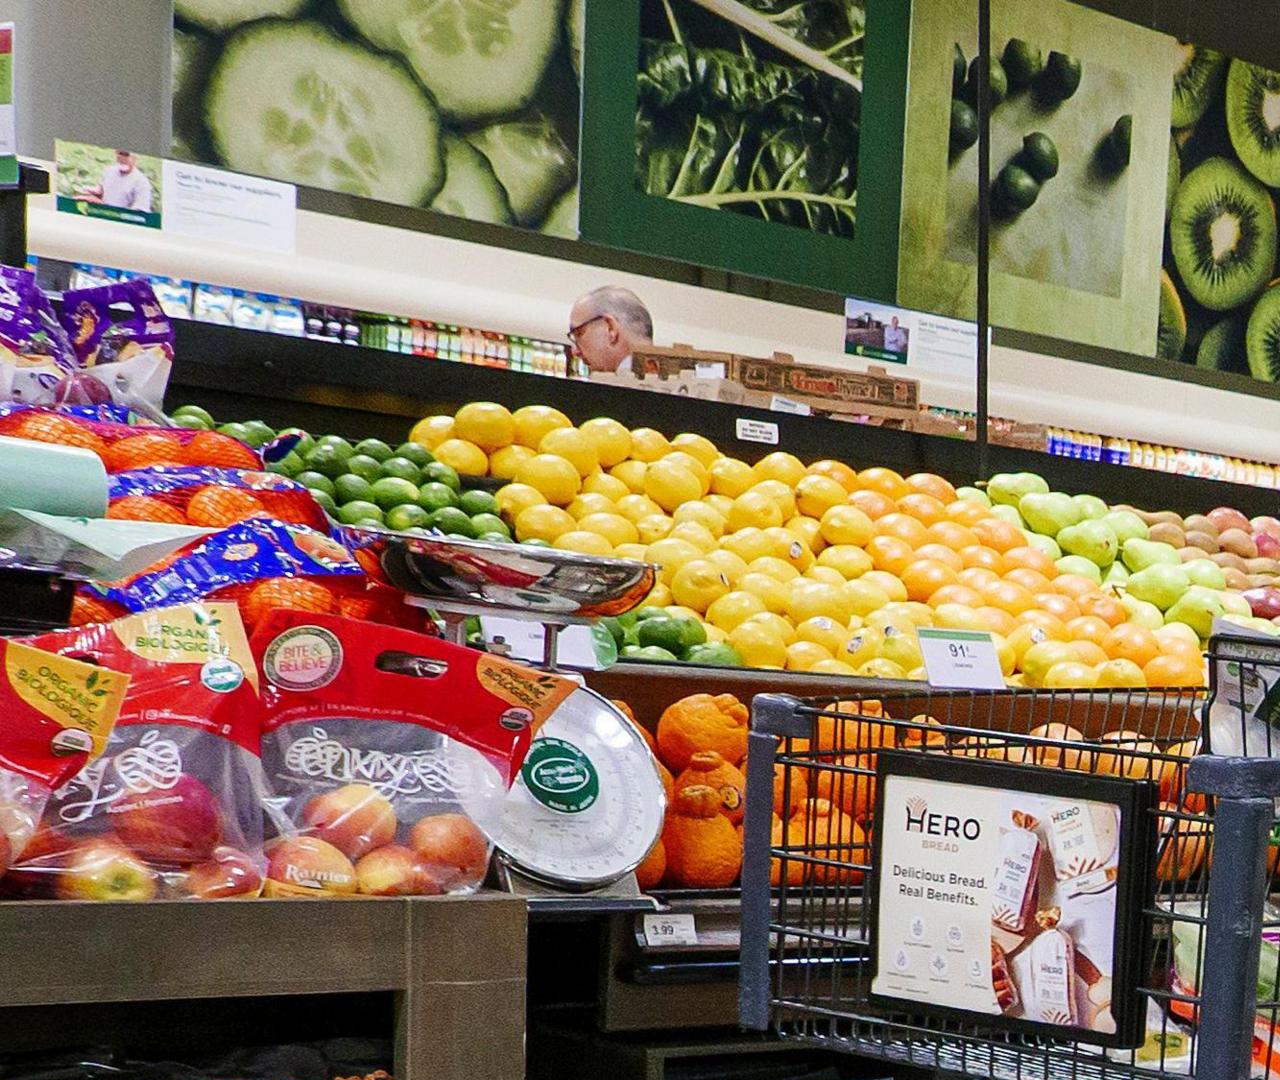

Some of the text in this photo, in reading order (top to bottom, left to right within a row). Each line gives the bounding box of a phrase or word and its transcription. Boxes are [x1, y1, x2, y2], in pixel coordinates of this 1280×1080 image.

[284, 645, 309, 659] BITE
[279, 658, 327, 673] BELIEVE
[38, 665, 99, 714] ORGANIC
[499, 666, 546, 700] ORGANIC
[16, 668, 99, 732] BIOLOGIQUE
[906, 806, 981, 841] HERO
[1052, 807, 1080, 824] HERO
[922, 840, 959, 853] BREAD
[286, 862, 351, 883] Rainier
[893, 865, 945, 884] Delicious
[949, 873, 988, 889] Bread.
[899, 884, 978, 906] Real Benefits.
